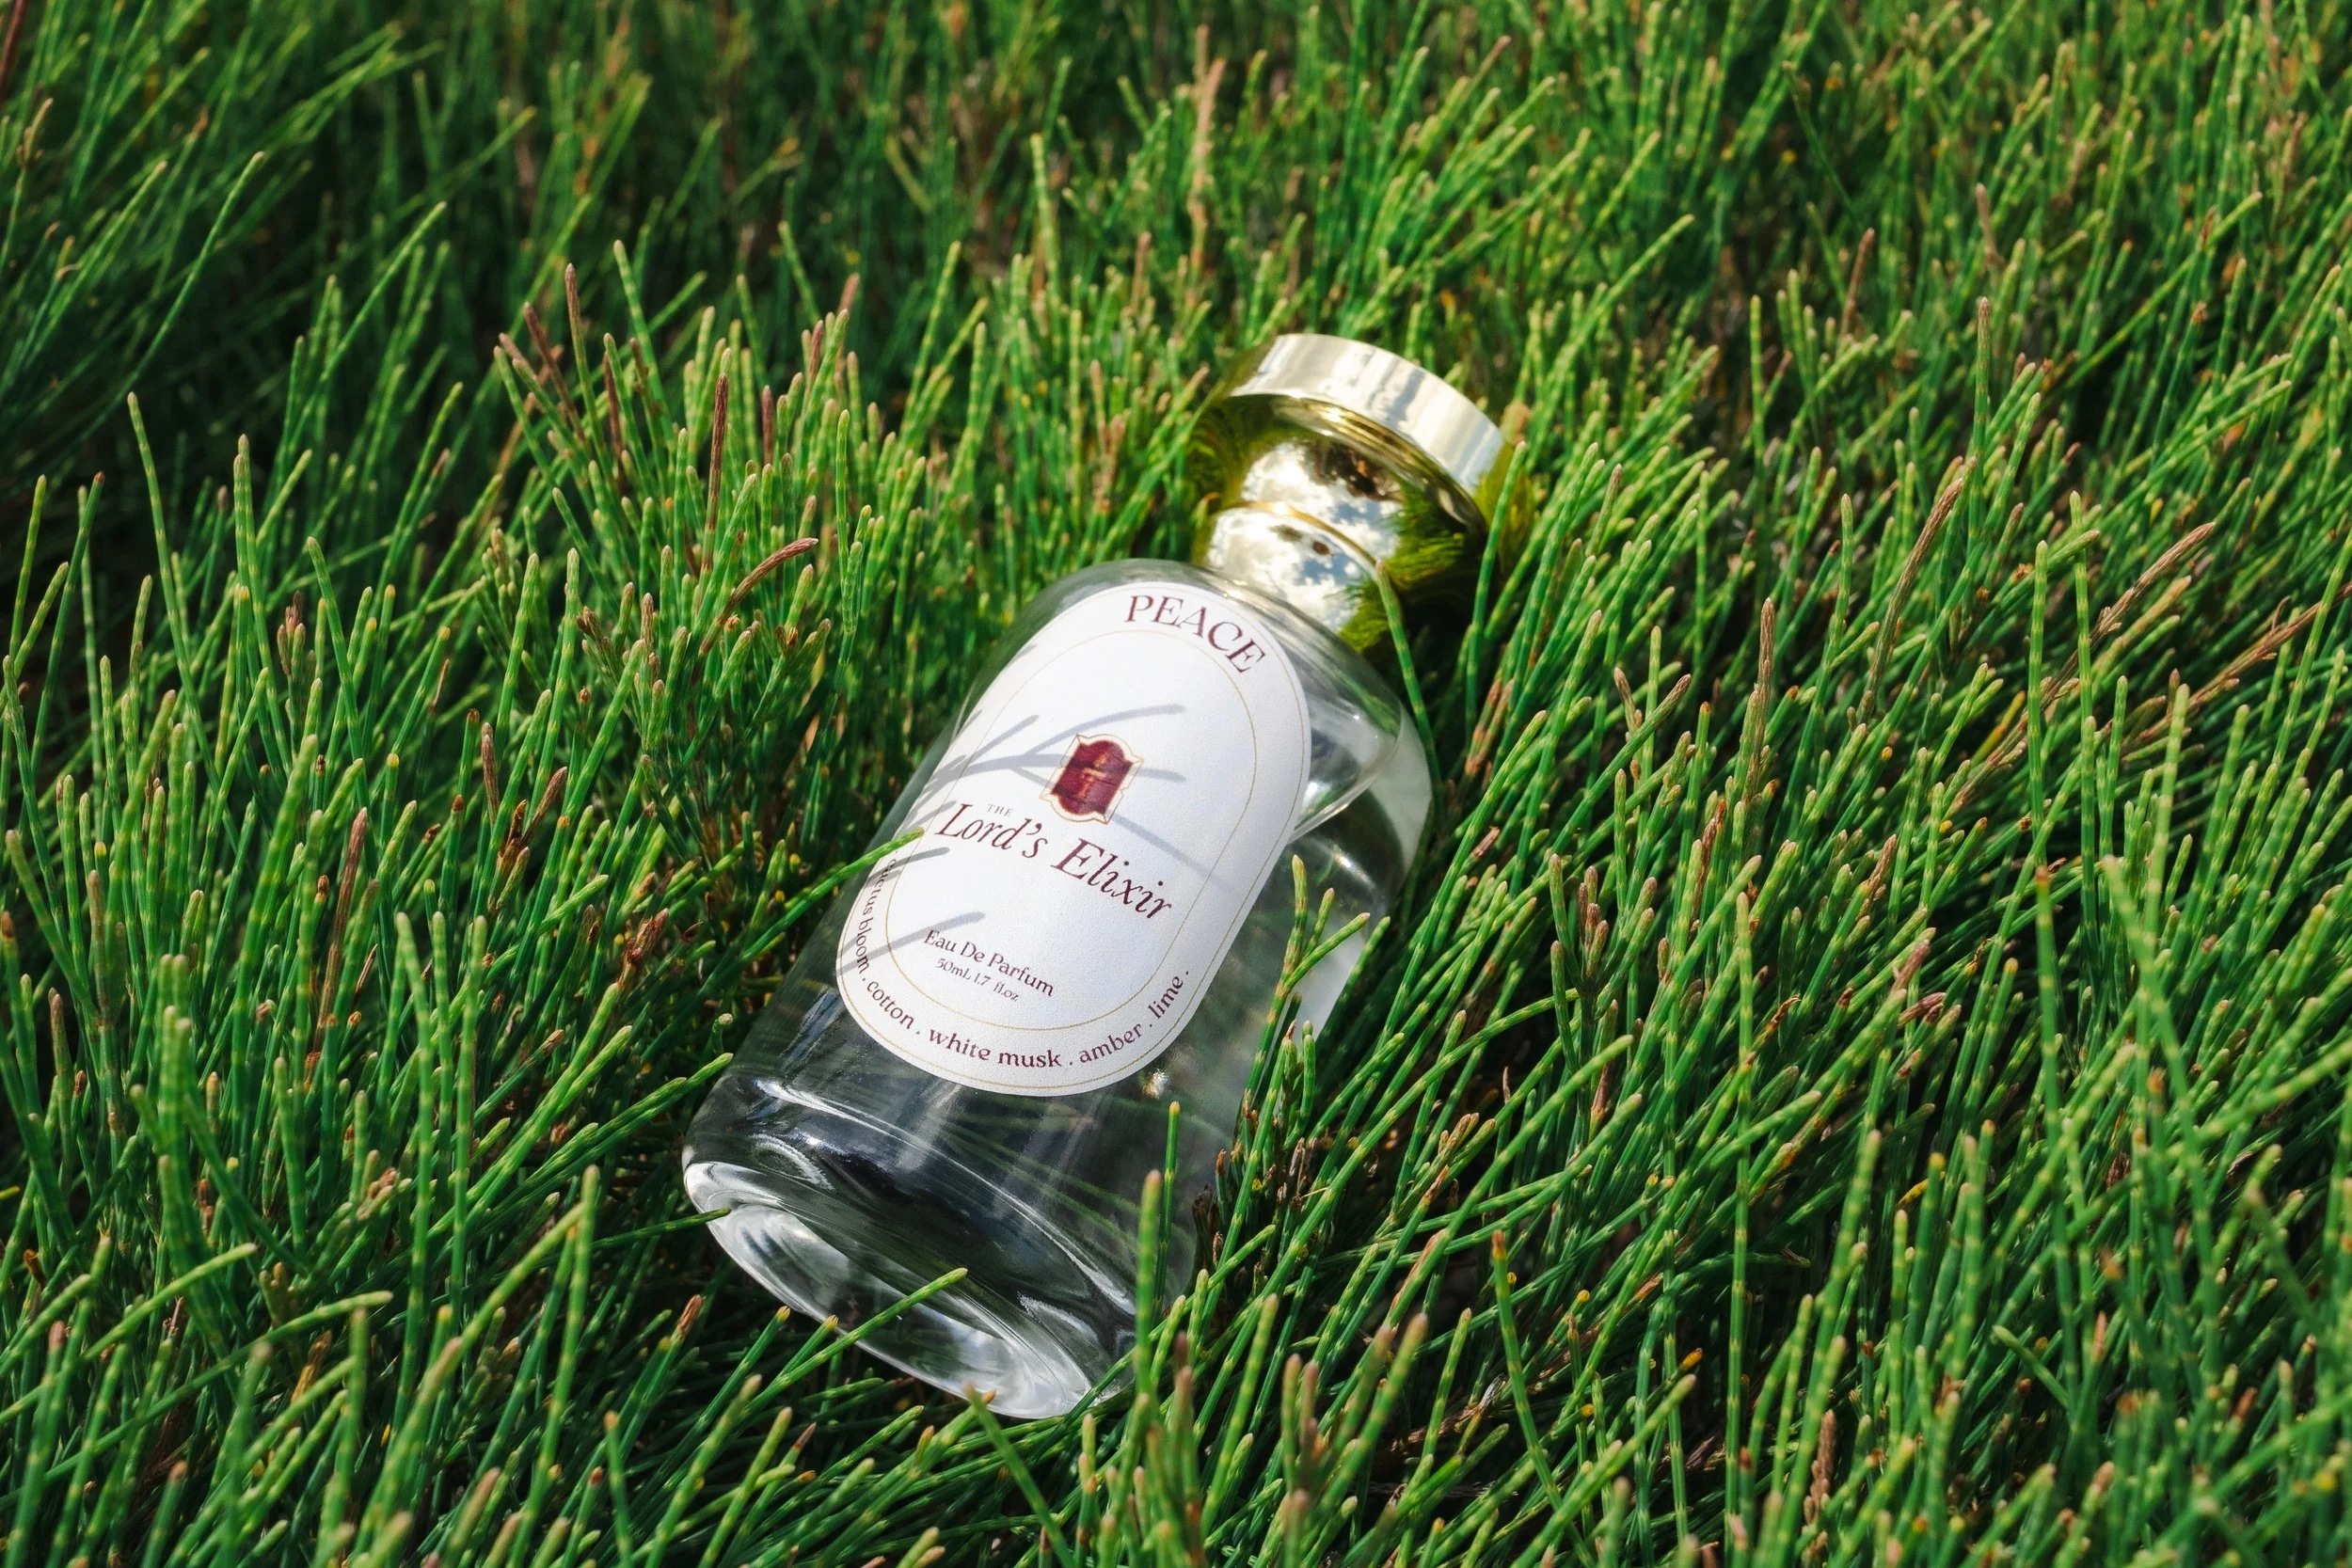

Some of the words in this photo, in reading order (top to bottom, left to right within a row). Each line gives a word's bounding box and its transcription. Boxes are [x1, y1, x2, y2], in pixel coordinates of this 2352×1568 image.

[1124, 594, 1266, 673] PEACE
[986, 802, 1013, 817] THE
[934, 802, 1048, 858] Lord's
[1050, 837, 1172, 919] Elixir
[863, 858, 897, 916] cactus
[855, 916, 874, 974] bloom
[923, 928, 957, 952] Eau
[960, 941, 986, 963] De
[987, 952, 1055, 997] Parfum
[936, 957, 973, 981] 50mL
[973, 972, 992, 987] 1.7
[866, 980, 914, 1029] cotton
[1147, 975, 1184, 1021] lime
[930, 1028, 991, 1061] white
[997, 1049, 1062, 1069] musk
[1079, 1022, 1142, 1064] amber
